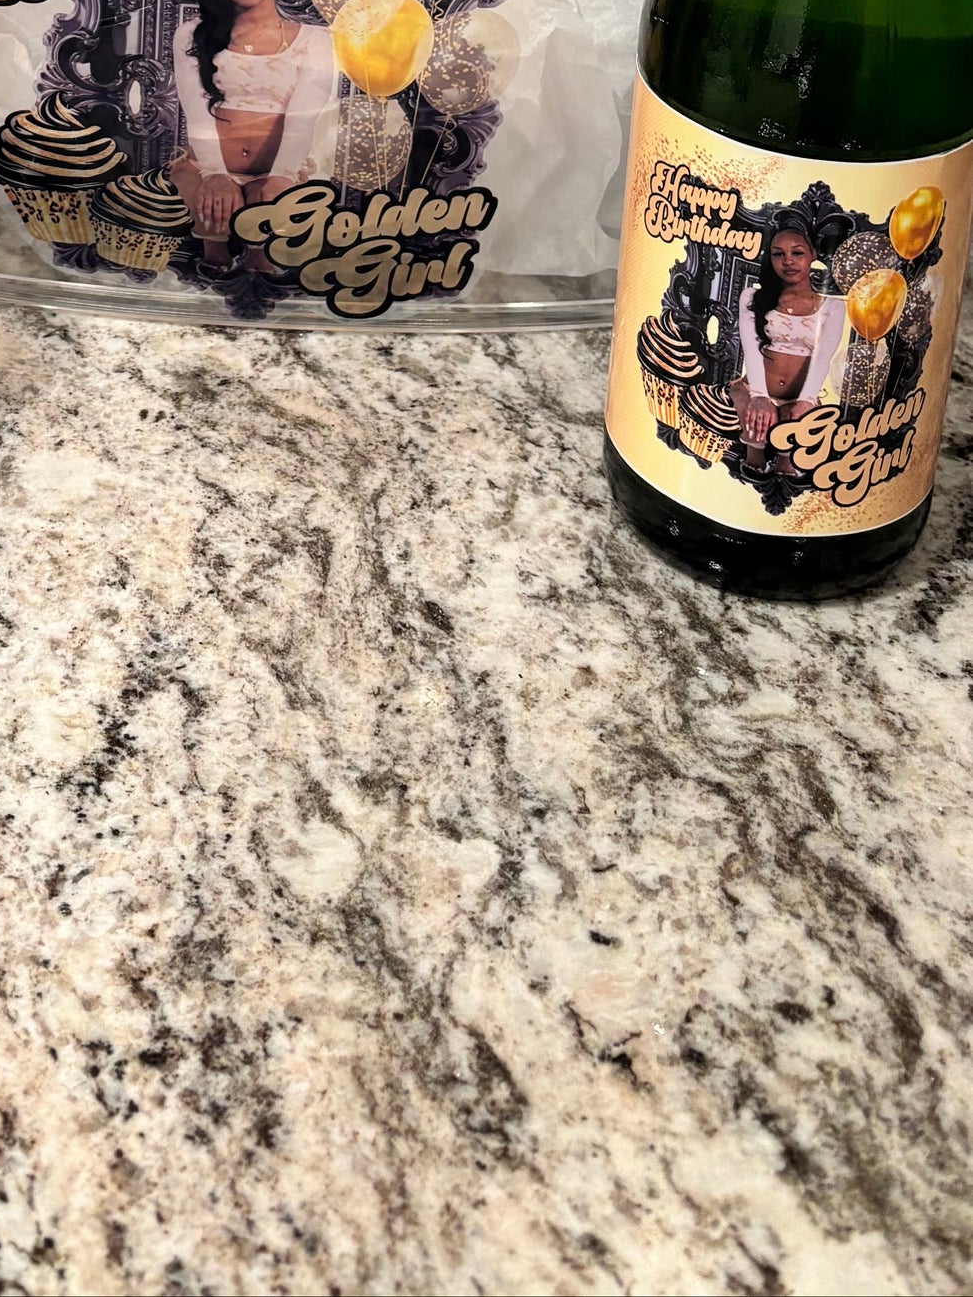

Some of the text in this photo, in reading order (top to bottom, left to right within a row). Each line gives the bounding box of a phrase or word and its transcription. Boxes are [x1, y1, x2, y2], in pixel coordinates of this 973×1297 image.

[234, 187, 490, 266] Golden
[645, 194, 762, 260] Birthday
[651, 162, 737, 220] Happy
[303, 240, 466, 312] Girl
[770, 391, 924, 469] Golden
[813, 430, 914, 505] Girl
